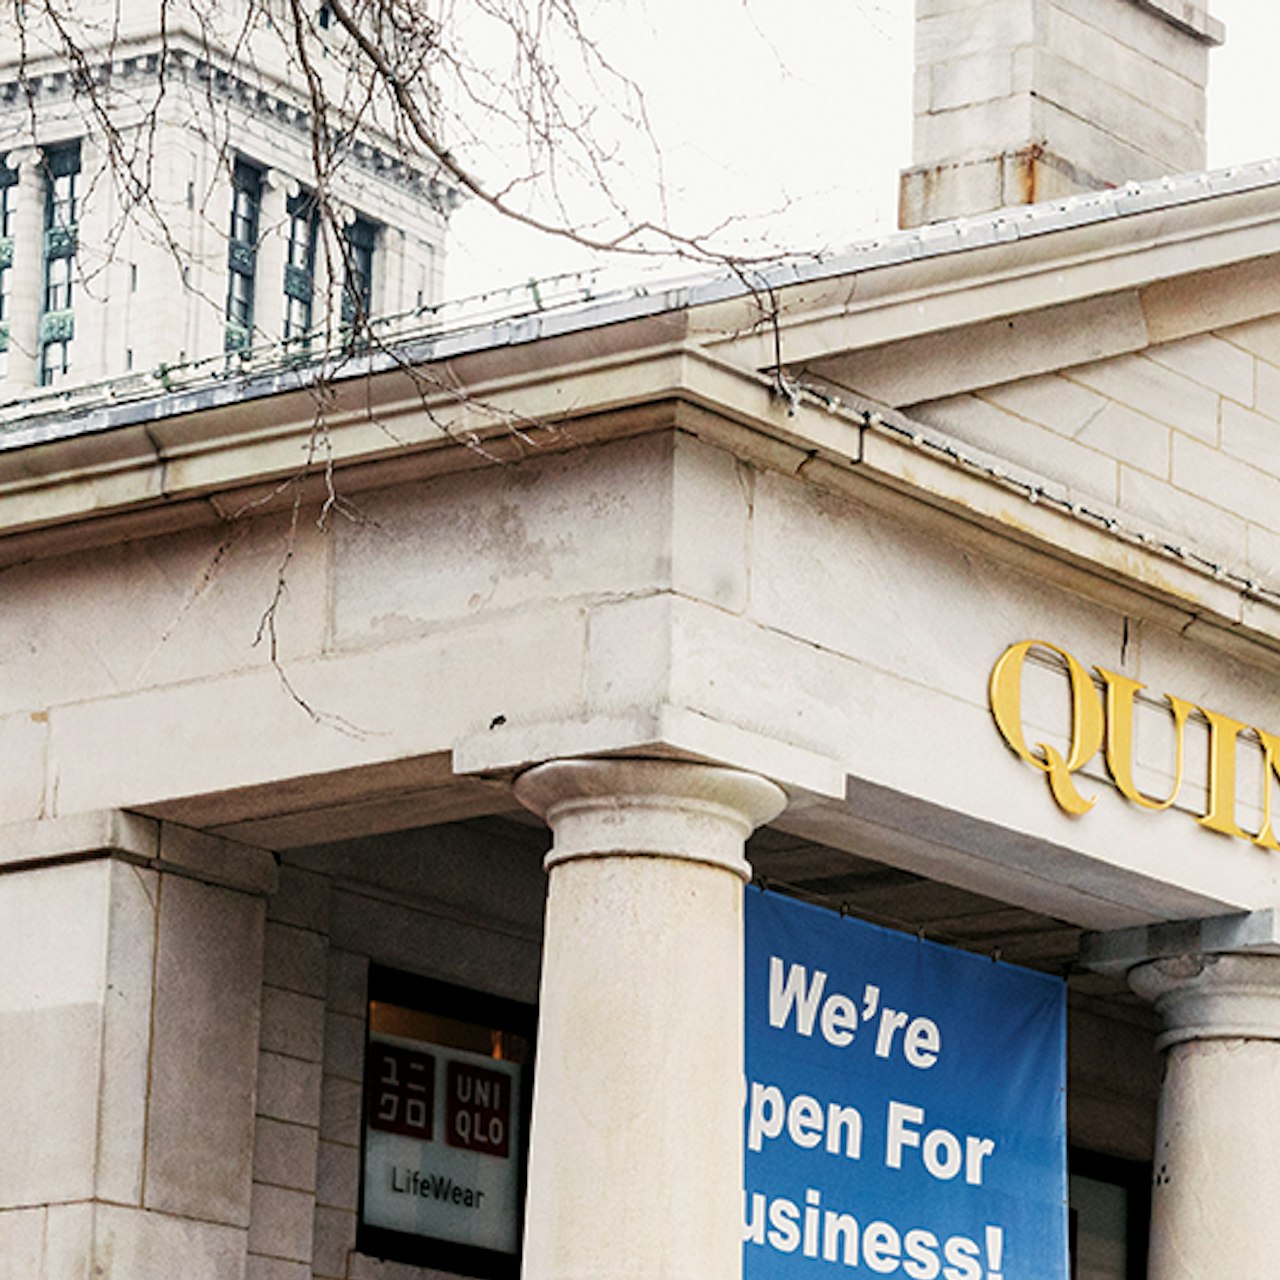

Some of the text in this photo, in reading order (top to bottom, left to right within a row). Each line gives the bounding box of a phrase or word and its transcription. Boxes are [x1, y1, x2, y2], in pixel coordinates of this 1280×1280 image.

[768, 956, 941, 1069] We’re
[456, 1074, 501, 1111] UNI
[455, 1110, 504, 1146] QLO
[740, 1074, 996, 1187] pen For
[391, 1166, 486, 1210] LifeWear
